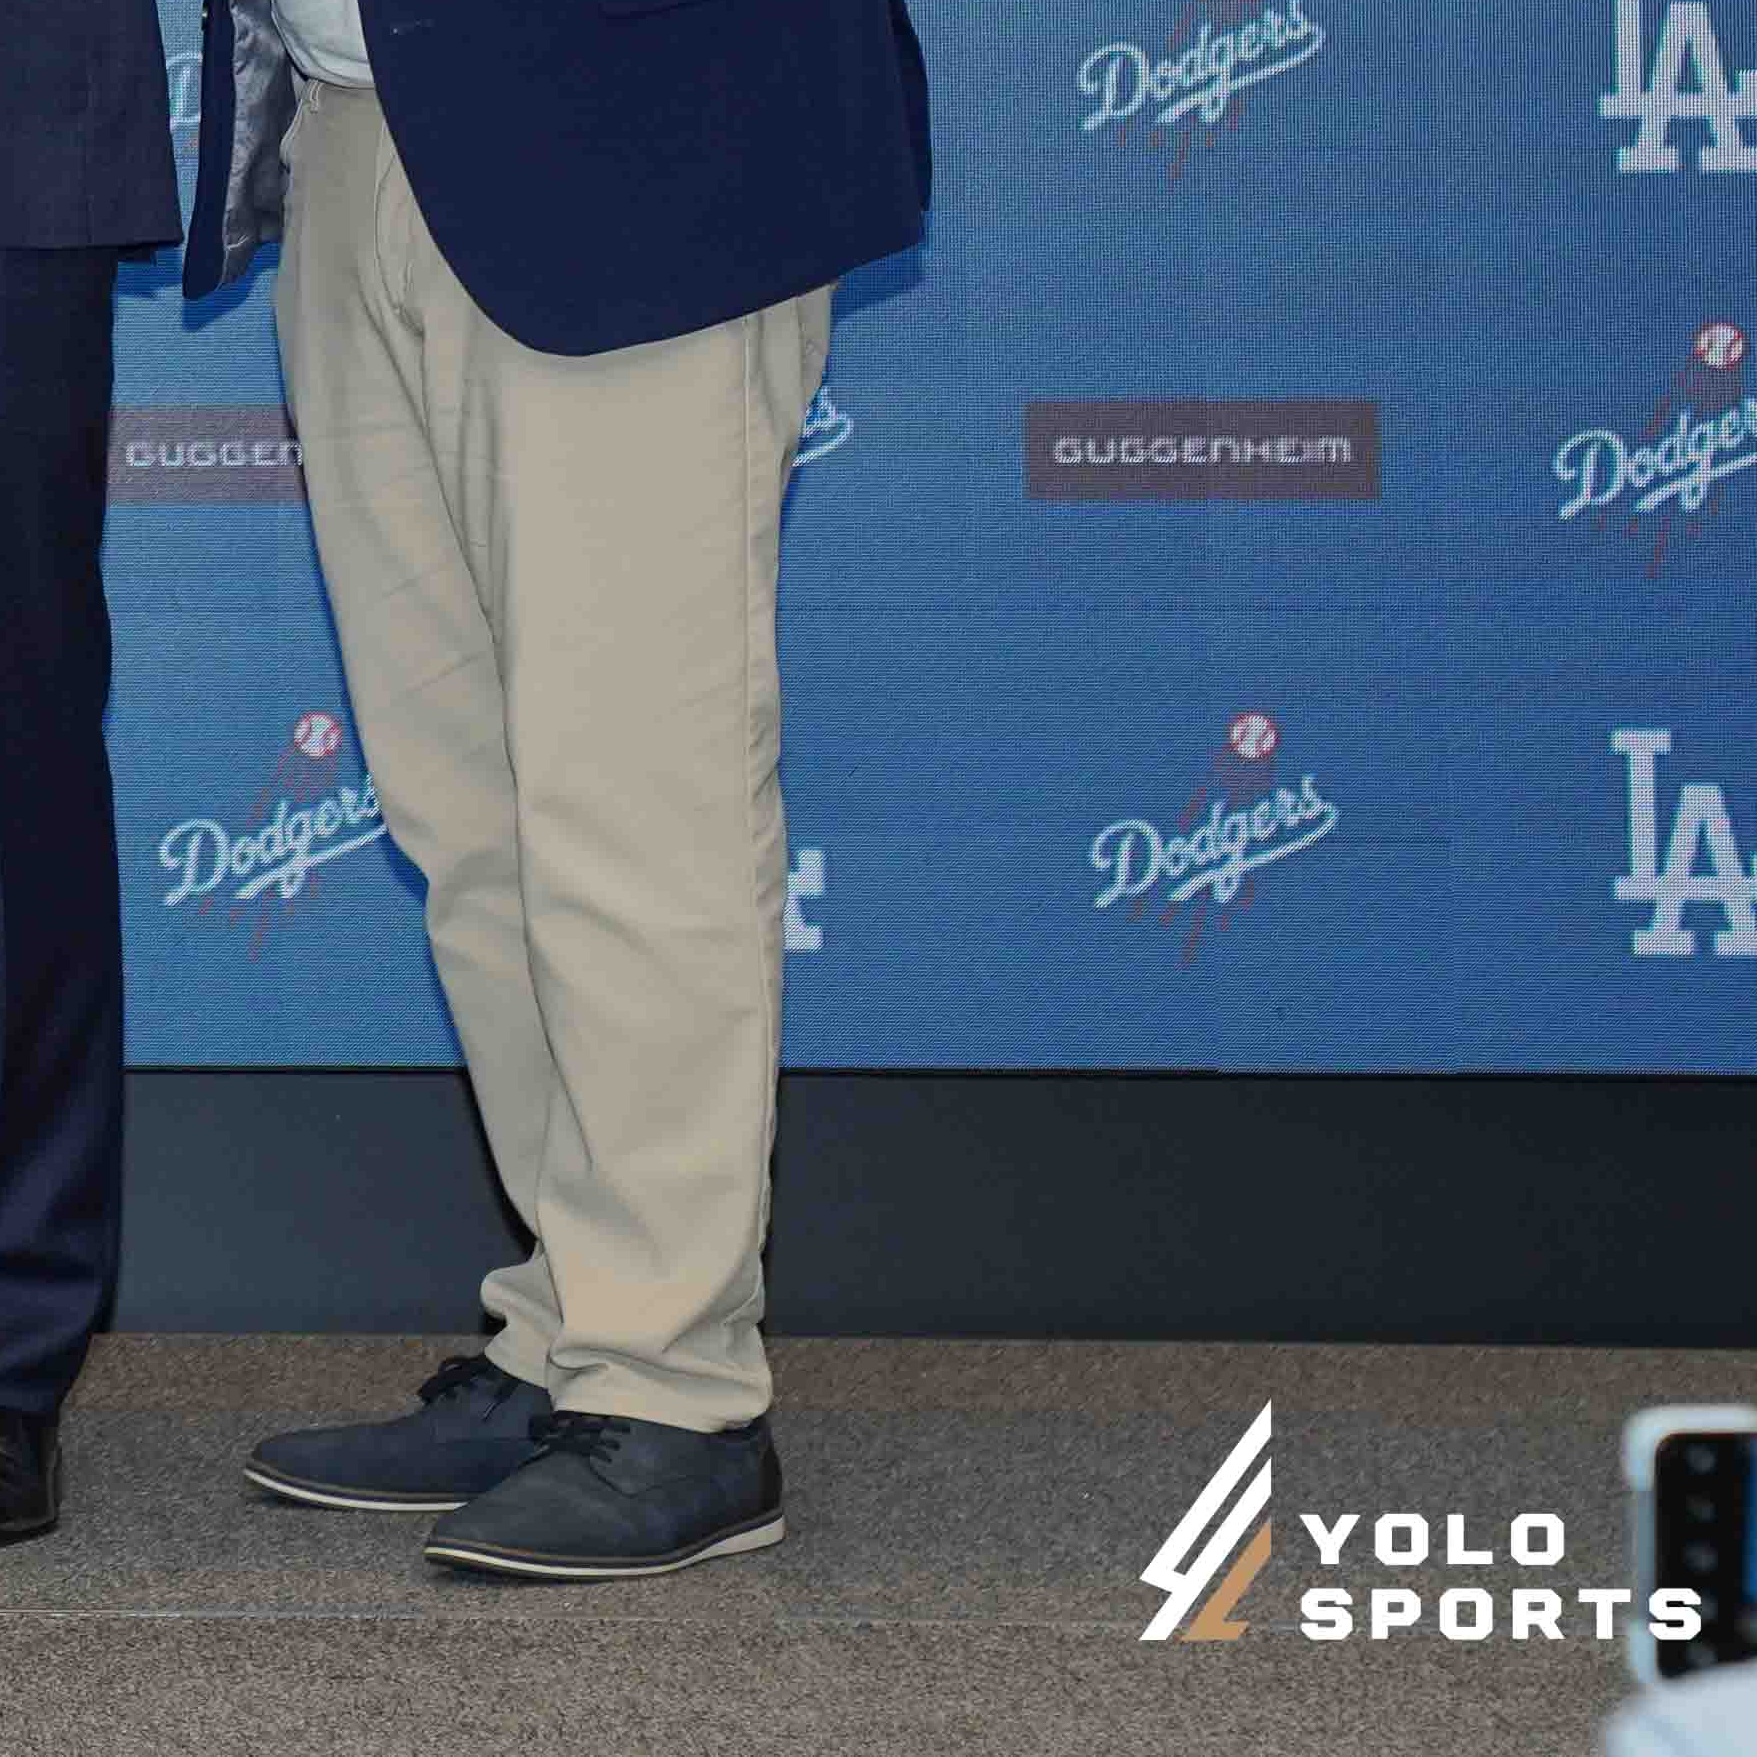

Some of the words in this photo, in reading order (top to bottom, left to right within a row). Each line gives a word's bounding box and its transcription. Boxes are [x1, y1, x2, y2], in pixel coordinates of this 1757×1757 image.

[1079, 2, 1322, 130] Dodgers
[125, 442, 303, 467] GUGGEN
[1053, 437, 1352, 465] GUGGENHEIM
[1092, 779, 1334, 907] Dodgers
[1614, 731, 1757, 955] LA
